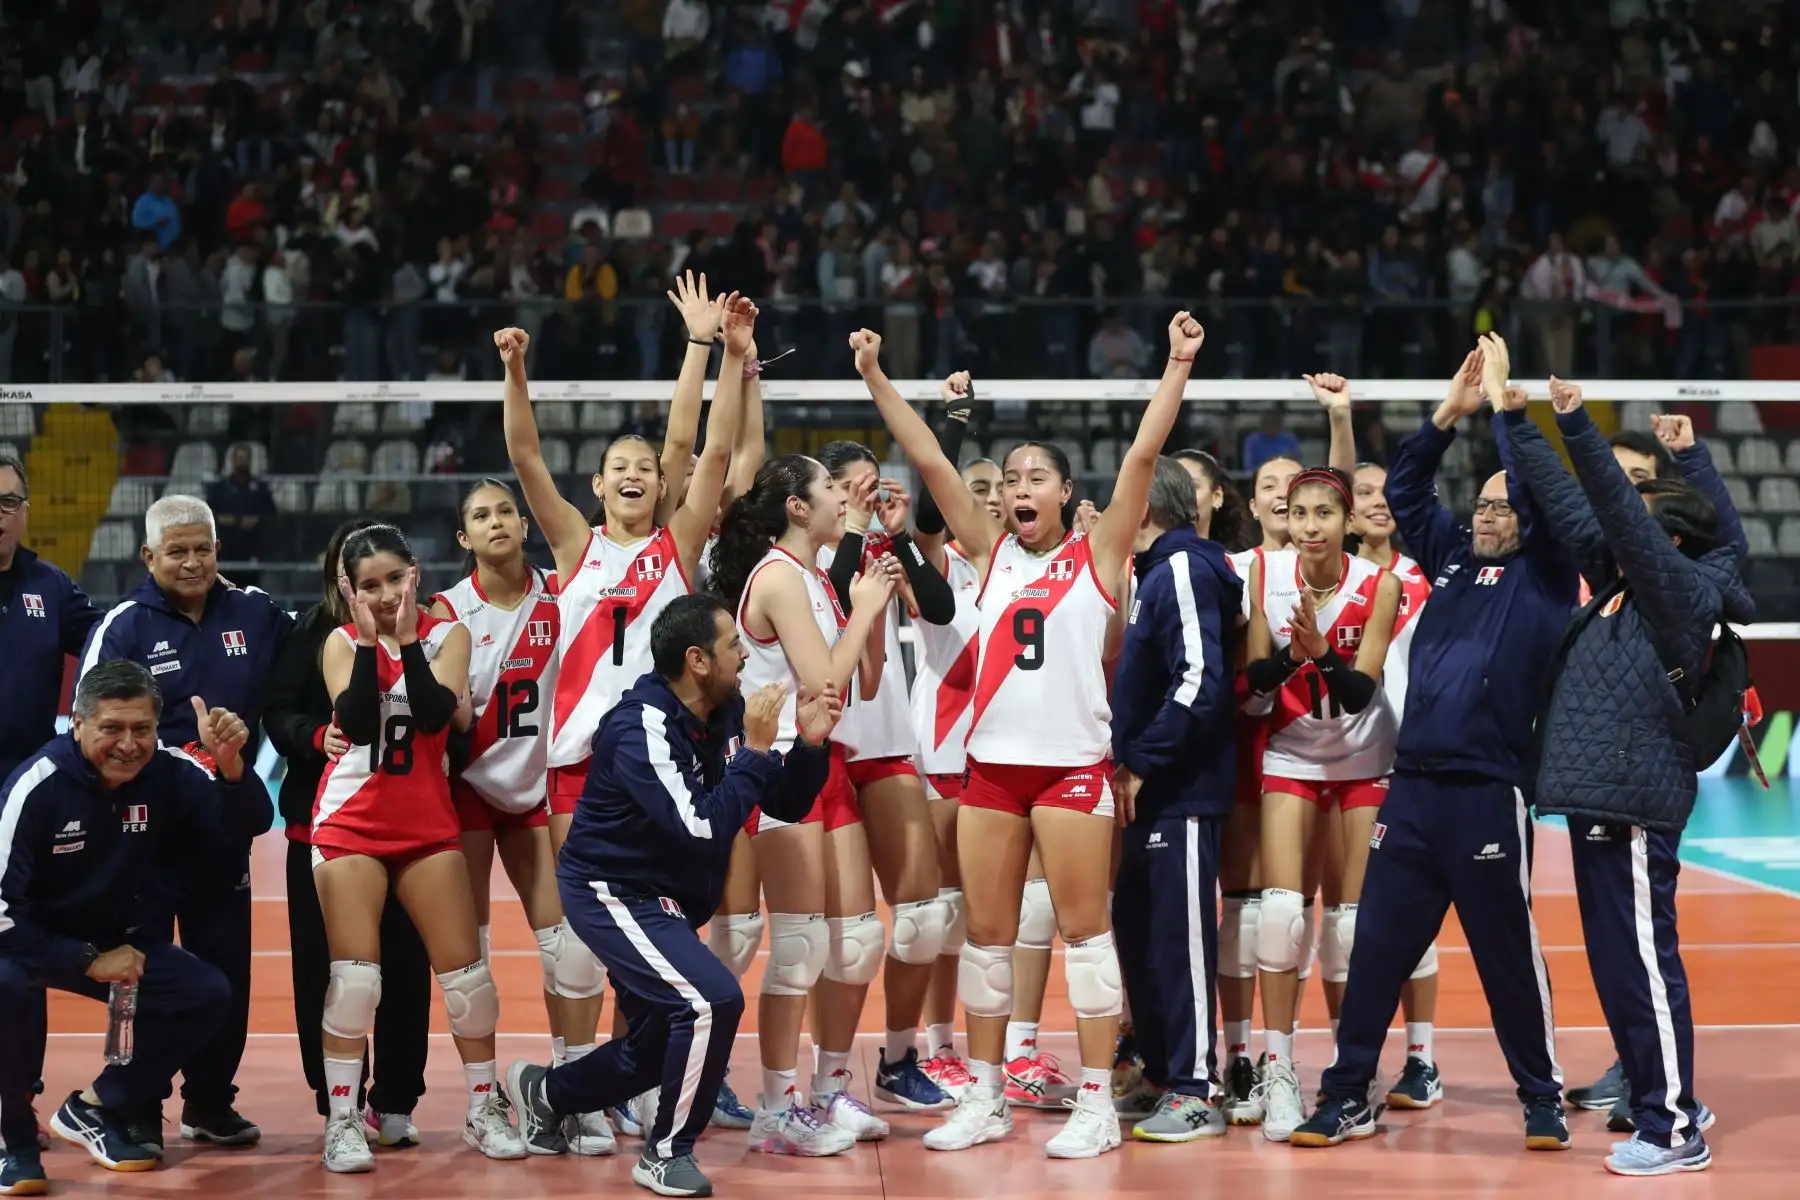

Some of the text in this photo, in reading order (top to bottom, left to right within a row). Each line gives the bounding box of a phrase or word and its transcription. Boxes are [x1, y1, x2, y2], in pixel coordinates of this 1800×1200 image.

[638, 571, 663, 582] PER
[1048, 573, 1073, 581] PER
[1475, 578, 1498, 586] PER
[26, 609, 46, 618] PER
[612, 606, 628, 667] 1
[1013, 608, 1045, 671] 9
[529, 637, 552, 647] PER
[226, 647, 248, 657] PER
[384, 693, 410, 704] SPORA
[495, 678, 540, 739] 12
[369, 714, 415, 776] 18
[123, 823, 147, 833] PER
